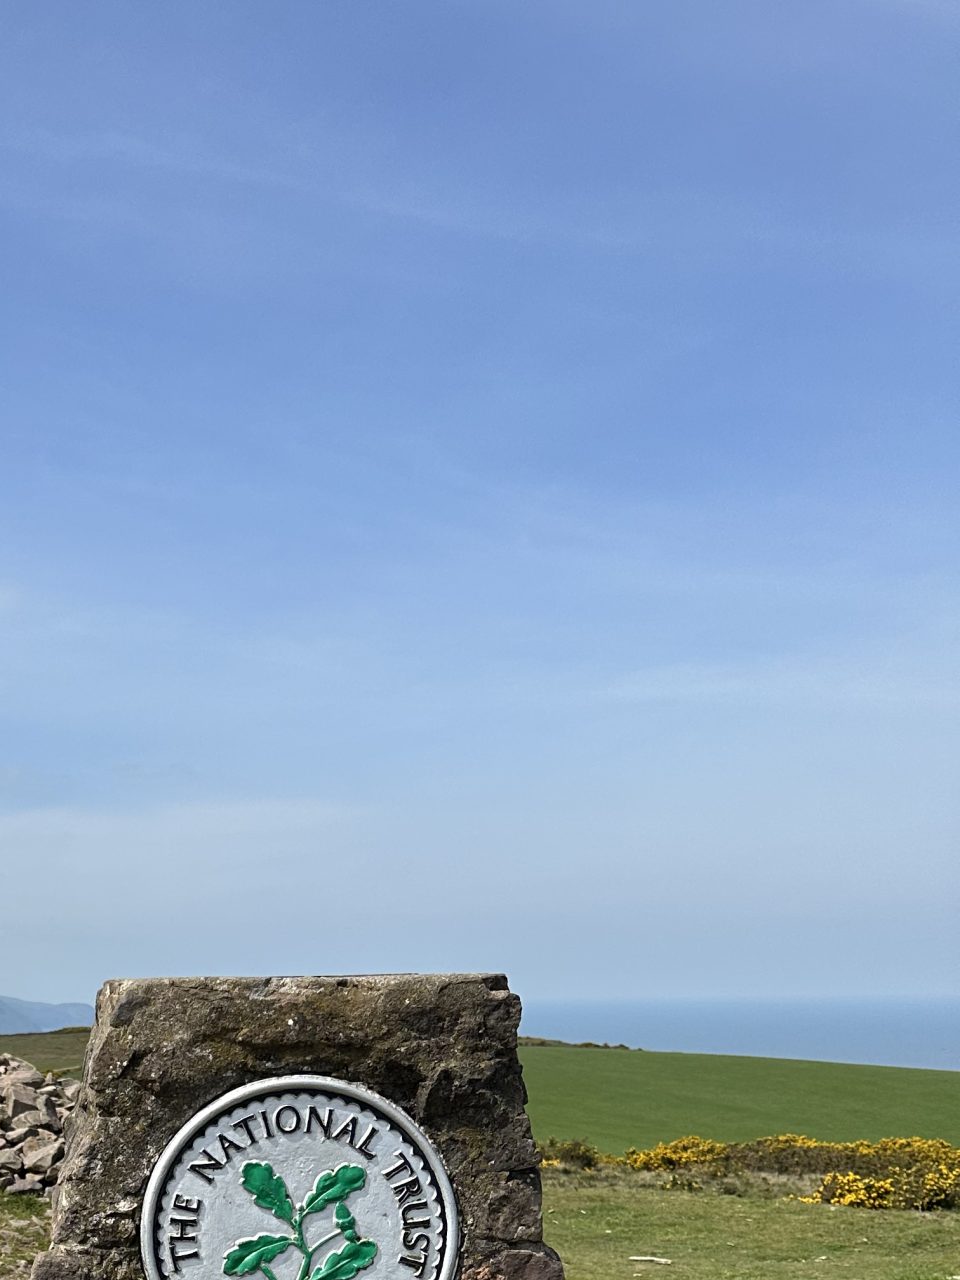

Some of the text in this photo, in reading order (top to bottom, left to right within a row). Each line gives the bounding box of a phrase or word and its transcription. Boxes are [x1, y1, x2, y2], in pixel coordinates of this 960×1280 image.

[169, 1104, 433, 1277] THE NATIONAL TRUST
